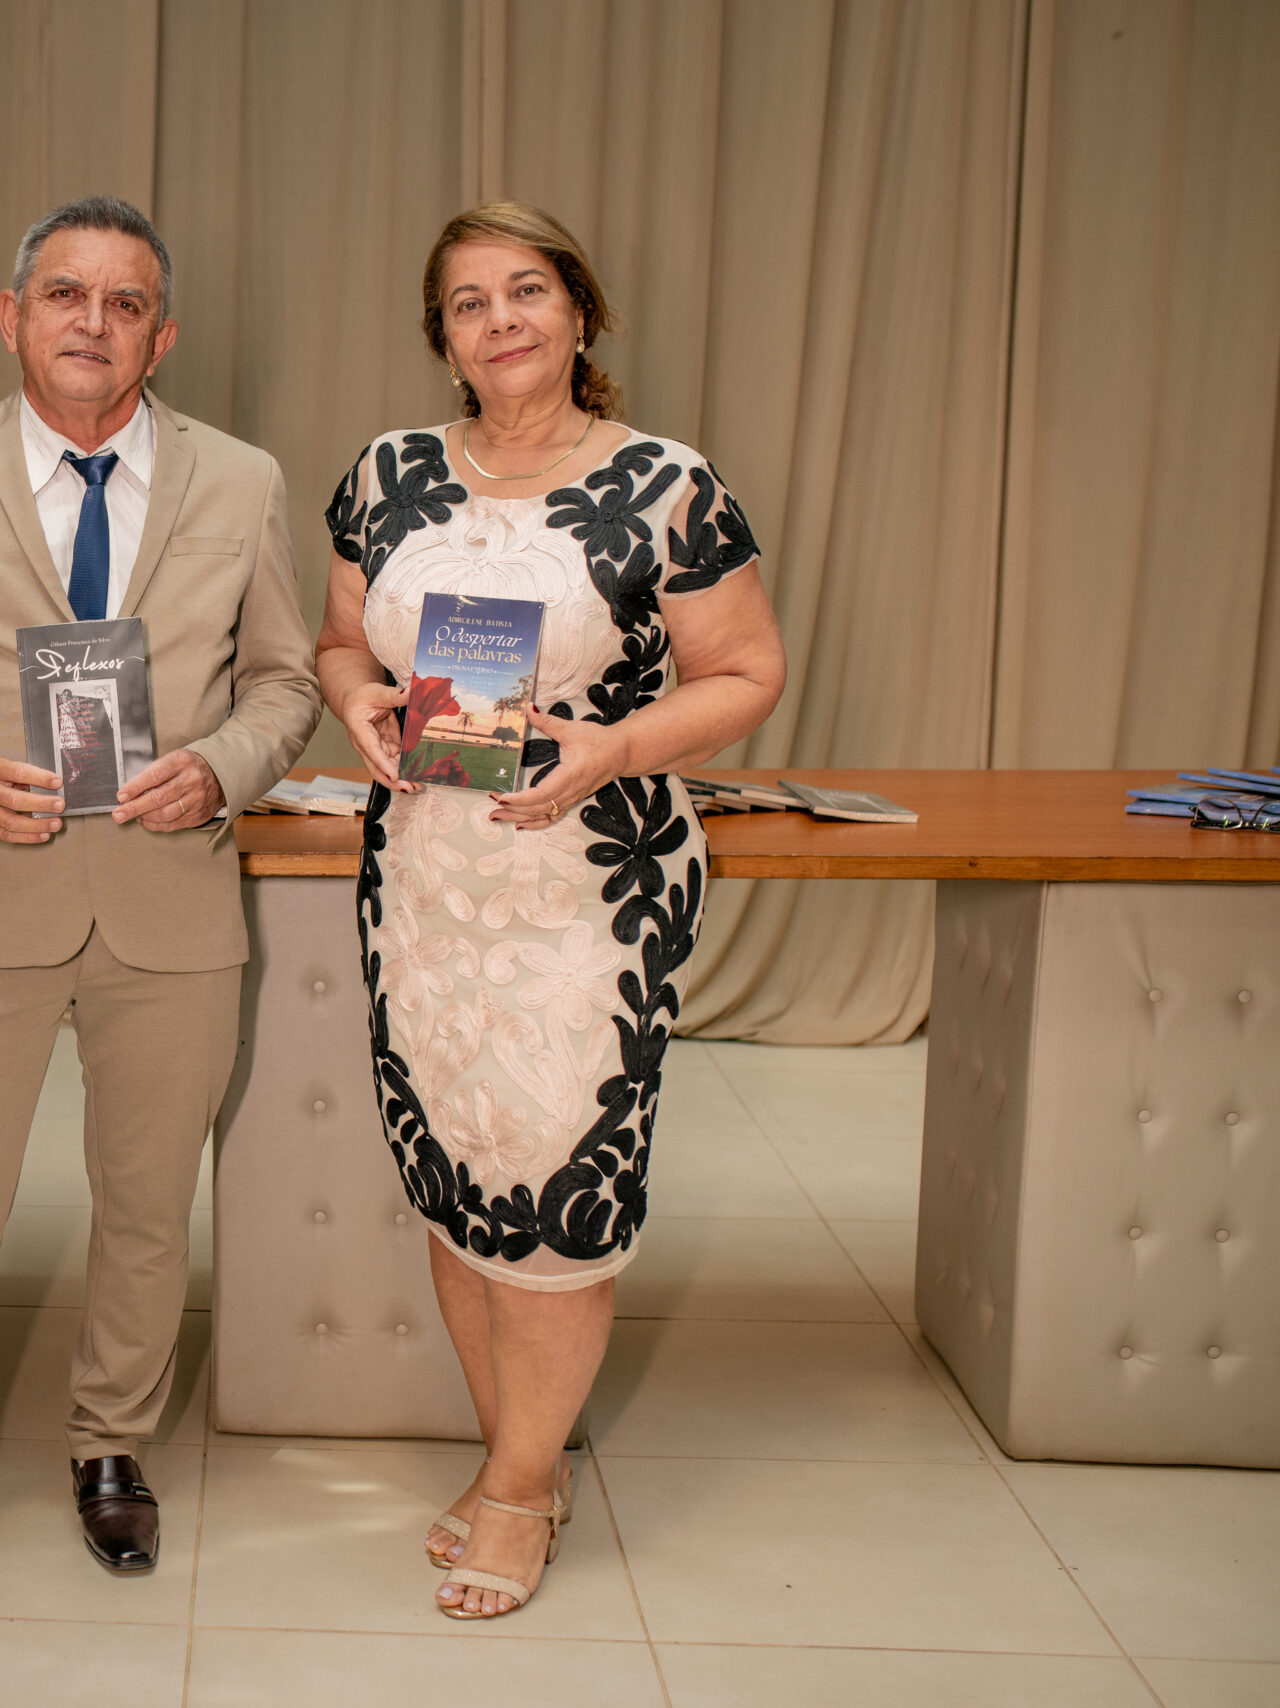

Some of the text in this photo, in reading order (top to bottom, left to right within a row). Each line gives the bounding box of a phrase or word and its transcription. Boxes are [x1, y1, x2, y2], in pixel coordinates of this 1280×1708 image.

[435, 625, 523, 648] O despertar
[35, 645, 125, 682] Reflexos
[428, 641, 522, 664] das palavras
